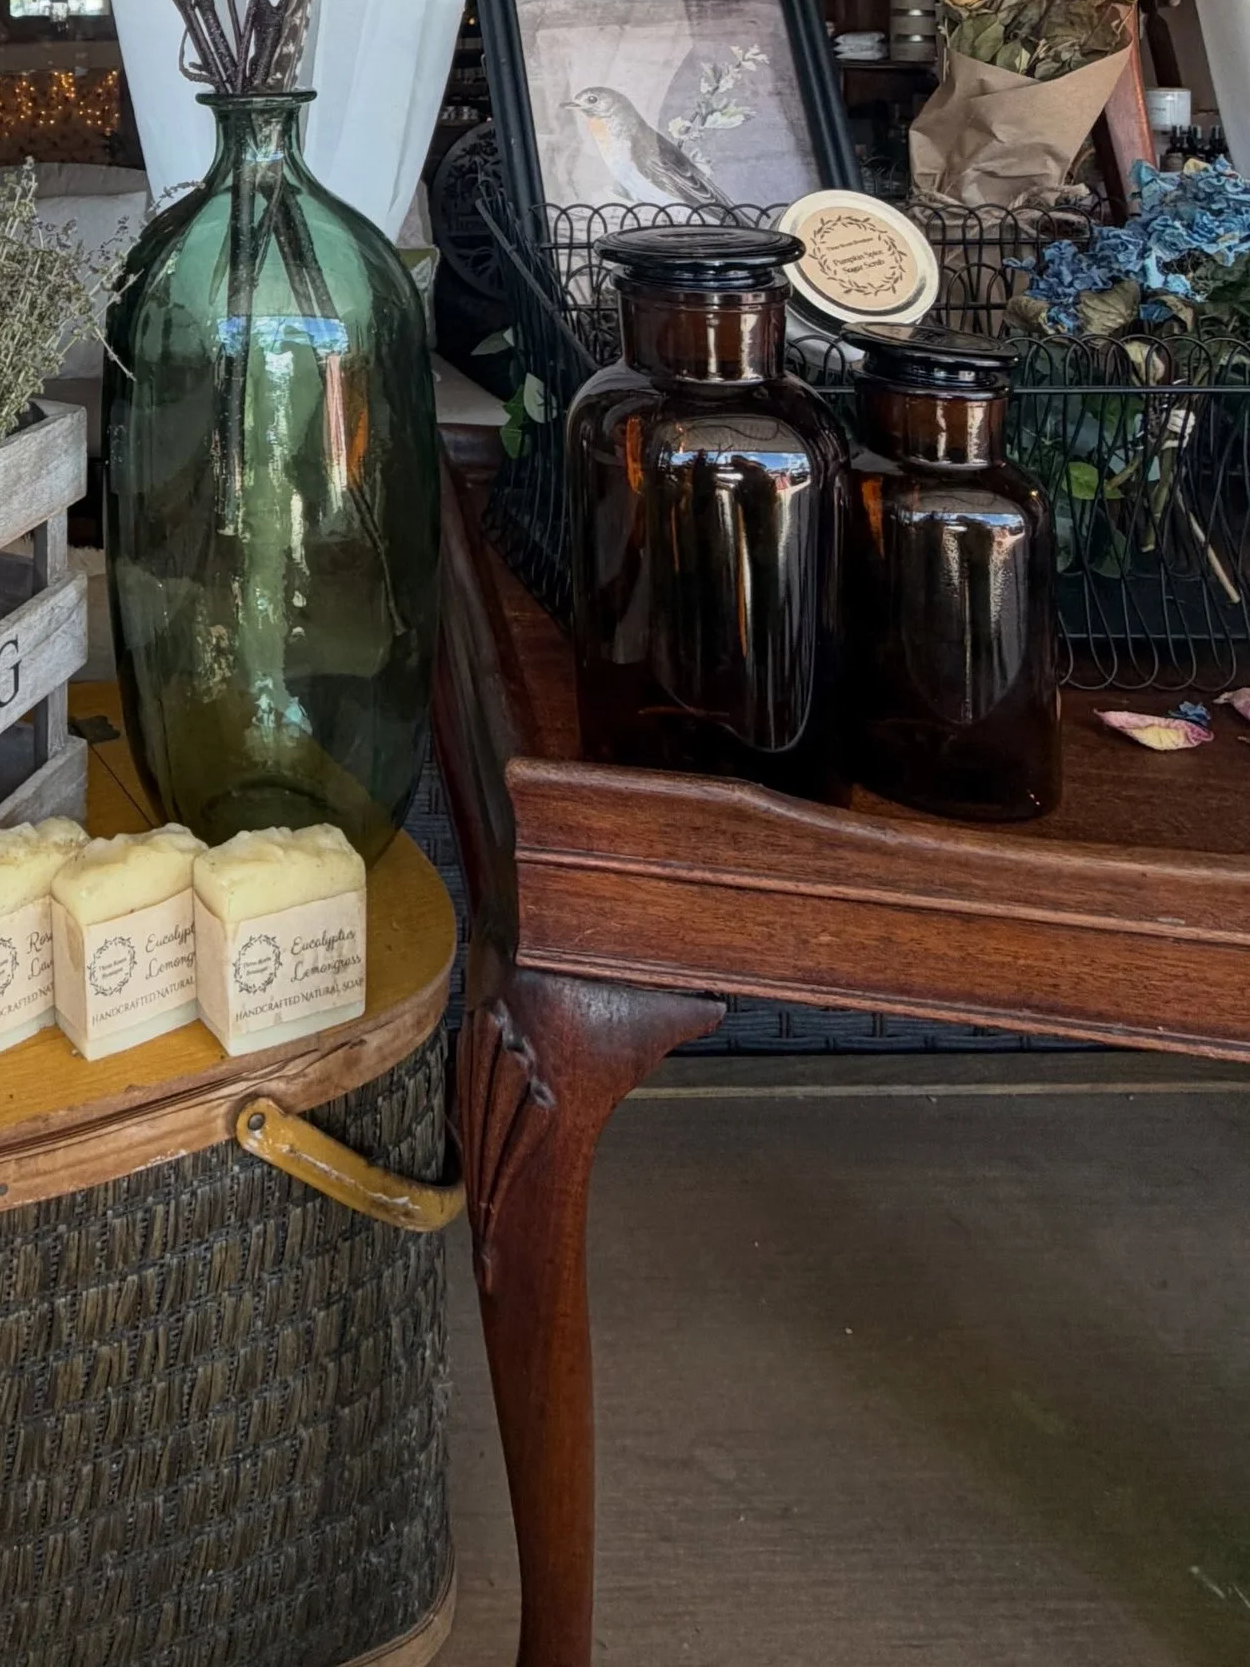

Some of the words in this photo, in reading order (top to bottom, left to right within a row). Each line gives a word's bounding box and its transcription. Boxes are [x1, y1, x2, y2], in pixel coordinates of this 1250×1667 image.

[832, 254, 864, 266] Pumpkin
[145, 920, 196, 954] Eucalypt
[291, 928, 356, 956] Eucalyptus
[145, 950, 196, 980] Lemong
[291, 954, 362, 983] Lemongrass
[91, 991, 157, 1027] HANDCRAFTED
[157, 975, 195, 999] NATURAL
[235, 994, 300, 1022] HANDCRAFTED
[300, 983, 341, 1003] NATURAL
[342, 976, 364, 992] SOAP
